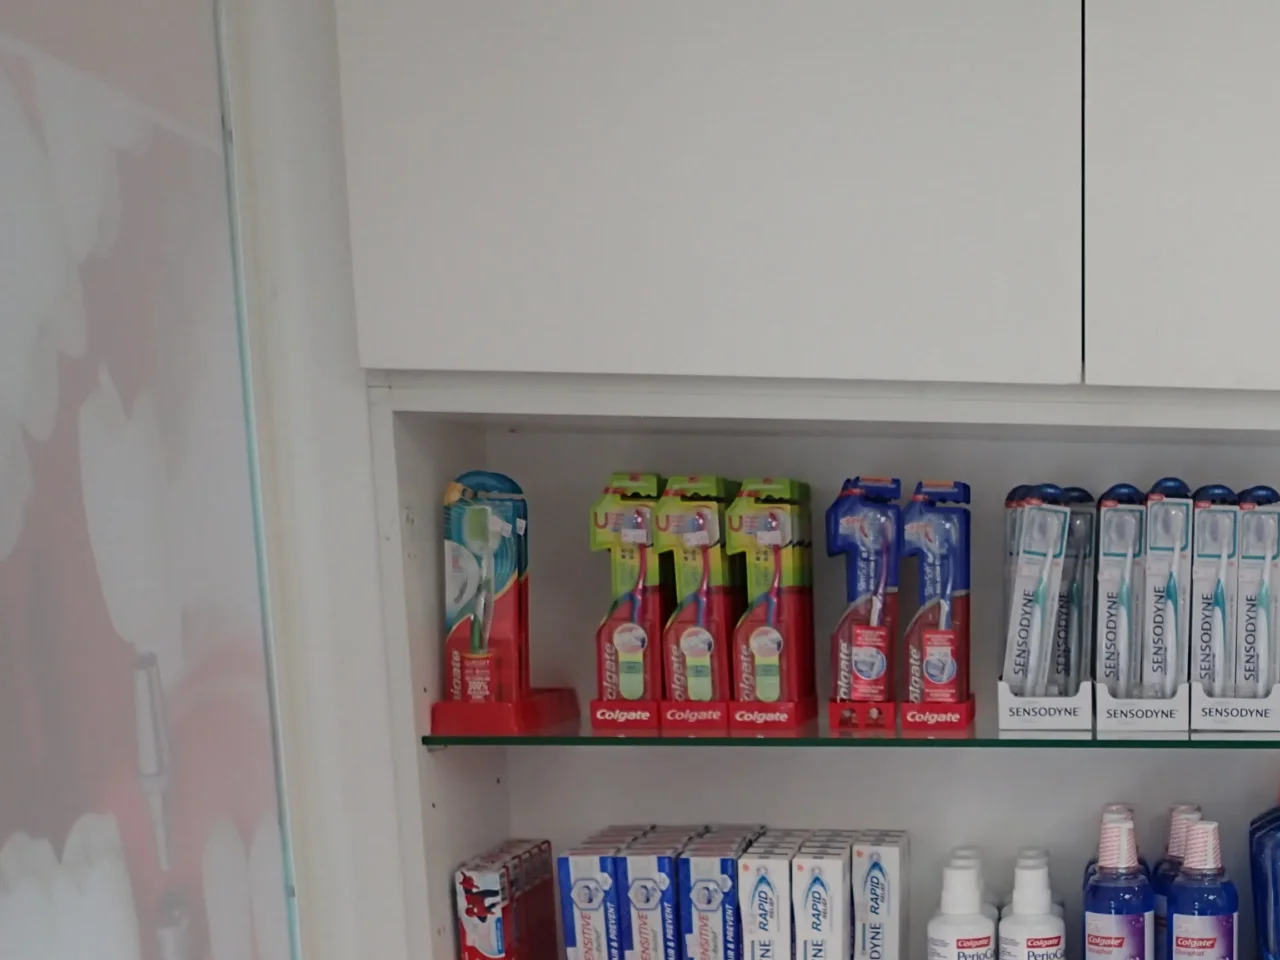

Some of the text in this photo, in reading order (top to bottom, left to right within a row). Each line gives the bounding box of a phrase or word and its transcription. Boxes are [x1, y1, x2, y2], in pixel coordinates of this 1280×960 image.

[1013, 589, 1035, 675] SENSODYNE
[1105, 591, 1119, 678] SENSODYNE
[1152, 586, 1165, 673] SENSODYNE
[1200, 592, 1213, 680] SENSODYNE
[1244, 595, 1257, 681] SENSODYNE
[596, 709, 650, 721] Colgate
[666, 709, 721, 721] Colgate
[735, 710, 789, 722] Colgate
[906, 711, 960, 724] Colgate
[1008, 707, 1079, 717] SENSODYNE
[1106, 709, 1176, 719] SENSODYNE
[1201, 707, 1271, 718] SENSODYNE
[758, 890, 768, 931] RAPID
[811, 890, 822, 932] RAPID
[869, 876, 880, 915] RAPID
[607, 902, 619, 940] PREVENT
[663, 901, 674, 939] PREVENT
[725, 904, 734, 941] PREVENT
[1088, 935, 1122, 946] Colgate
[1177, 938, 1212, 948] Colgate
